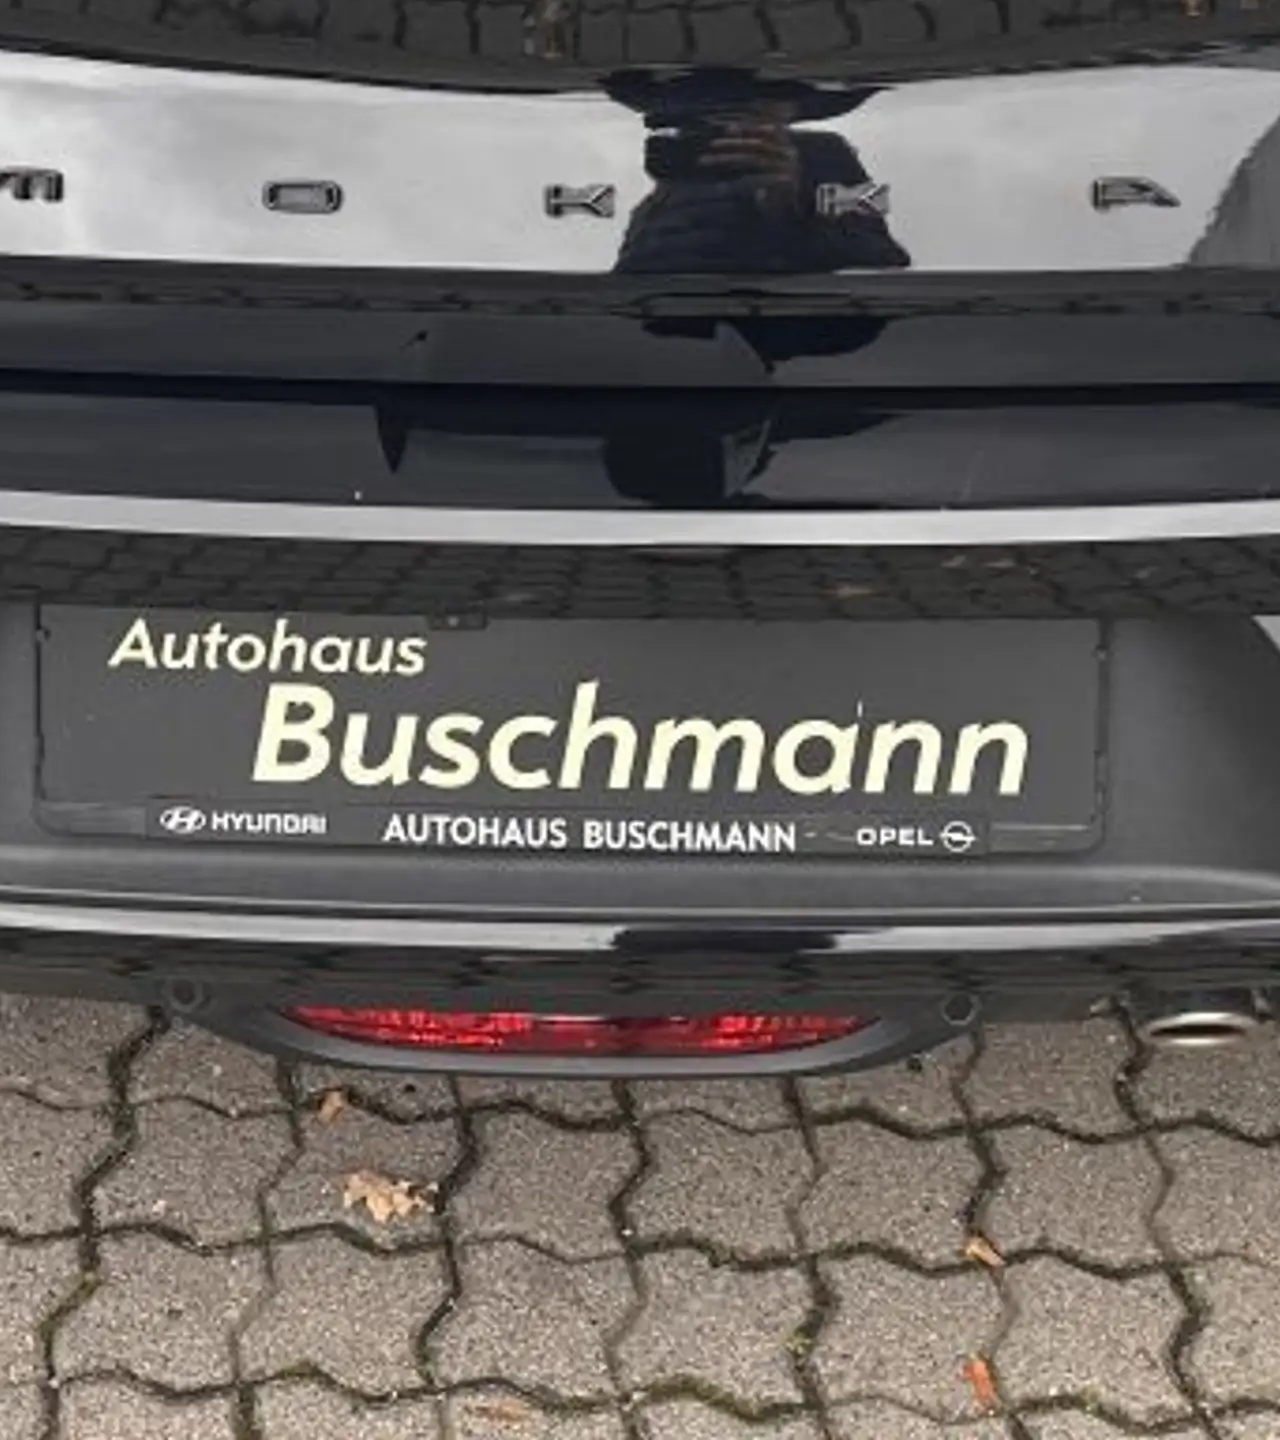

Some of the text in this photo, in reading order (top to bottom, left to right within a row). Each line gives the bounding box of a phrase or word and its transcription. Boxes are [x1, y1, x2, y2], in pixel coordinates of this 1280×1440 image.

[108, 618, 427, 675] Autohaus
[253, 680, 1029, 795] Buschmann
[211, 811, 327, 835] HYUNDAI
[383, 813, 796, 853] AUTOHAUS BUSCHMANN
[856, 827, 934, 846] OPEL
